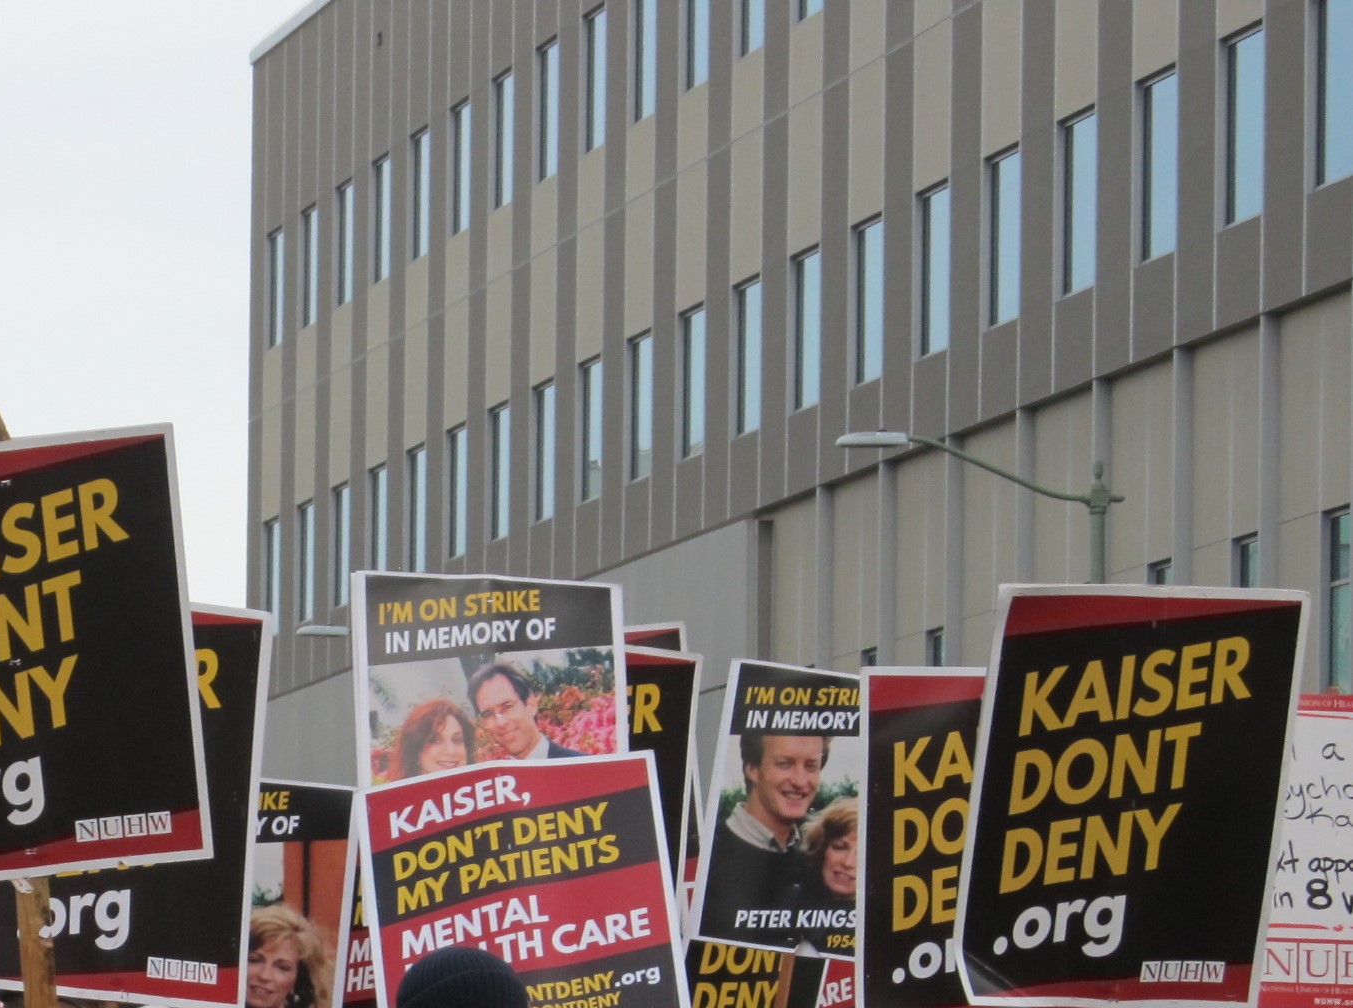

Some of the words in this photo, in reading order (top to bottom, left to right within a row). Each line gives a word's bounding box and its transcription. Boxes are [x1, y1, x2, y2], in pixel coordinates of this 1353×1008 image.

[378, 603, 412, 624] I'M
[419, 599, 456, 621] ON
[464, 589, 540, 616] STRIKE
[385, 632, 409, 654] IN
[416, 619, 521, 651] MEMORY
[525, 617, 556, 641] OF
[745, 686, 775, 705] I'M
[780, 688, 811, 706] ON
[815, 687, 860, 707] STRI
[1018, 635, 1252, 738] KAISER
[746, 710, 767, 728] IN
[772, 711, 860, 730] MEMORY
[1008, 723, 1201, 816] DONT
[75, 811, 172, 842] NUHW
[271, 815, 300, 835] OF
[390, 775, 531, 839] KAISER,
[393, 822, 503, 881] DON'T
[513, 802, 608, 847] DENY
[893, 798, 970, 864] DO
[999, 803, 1183, 895] DENY
[398, 871, 449, 916] MY
[459, 834, 619, 894] PATIENTS
[1306, 878, 1332, 910] 8
[38, 889, 131, 950] org
[735, 910, 791, 928] PETER
[797, 910, 856, 928] KINGS
[892, 866, 958, 932] DE
[401, 895, 549, 960] MENTAL
[551, 907, 651, 954] CARE
[992, 894, 1127, 957] .org
[147, 956, 218, 984] NUHW
[699, 942, 783, 974] DON
[1140, 961, 1225, 983] NUHW
